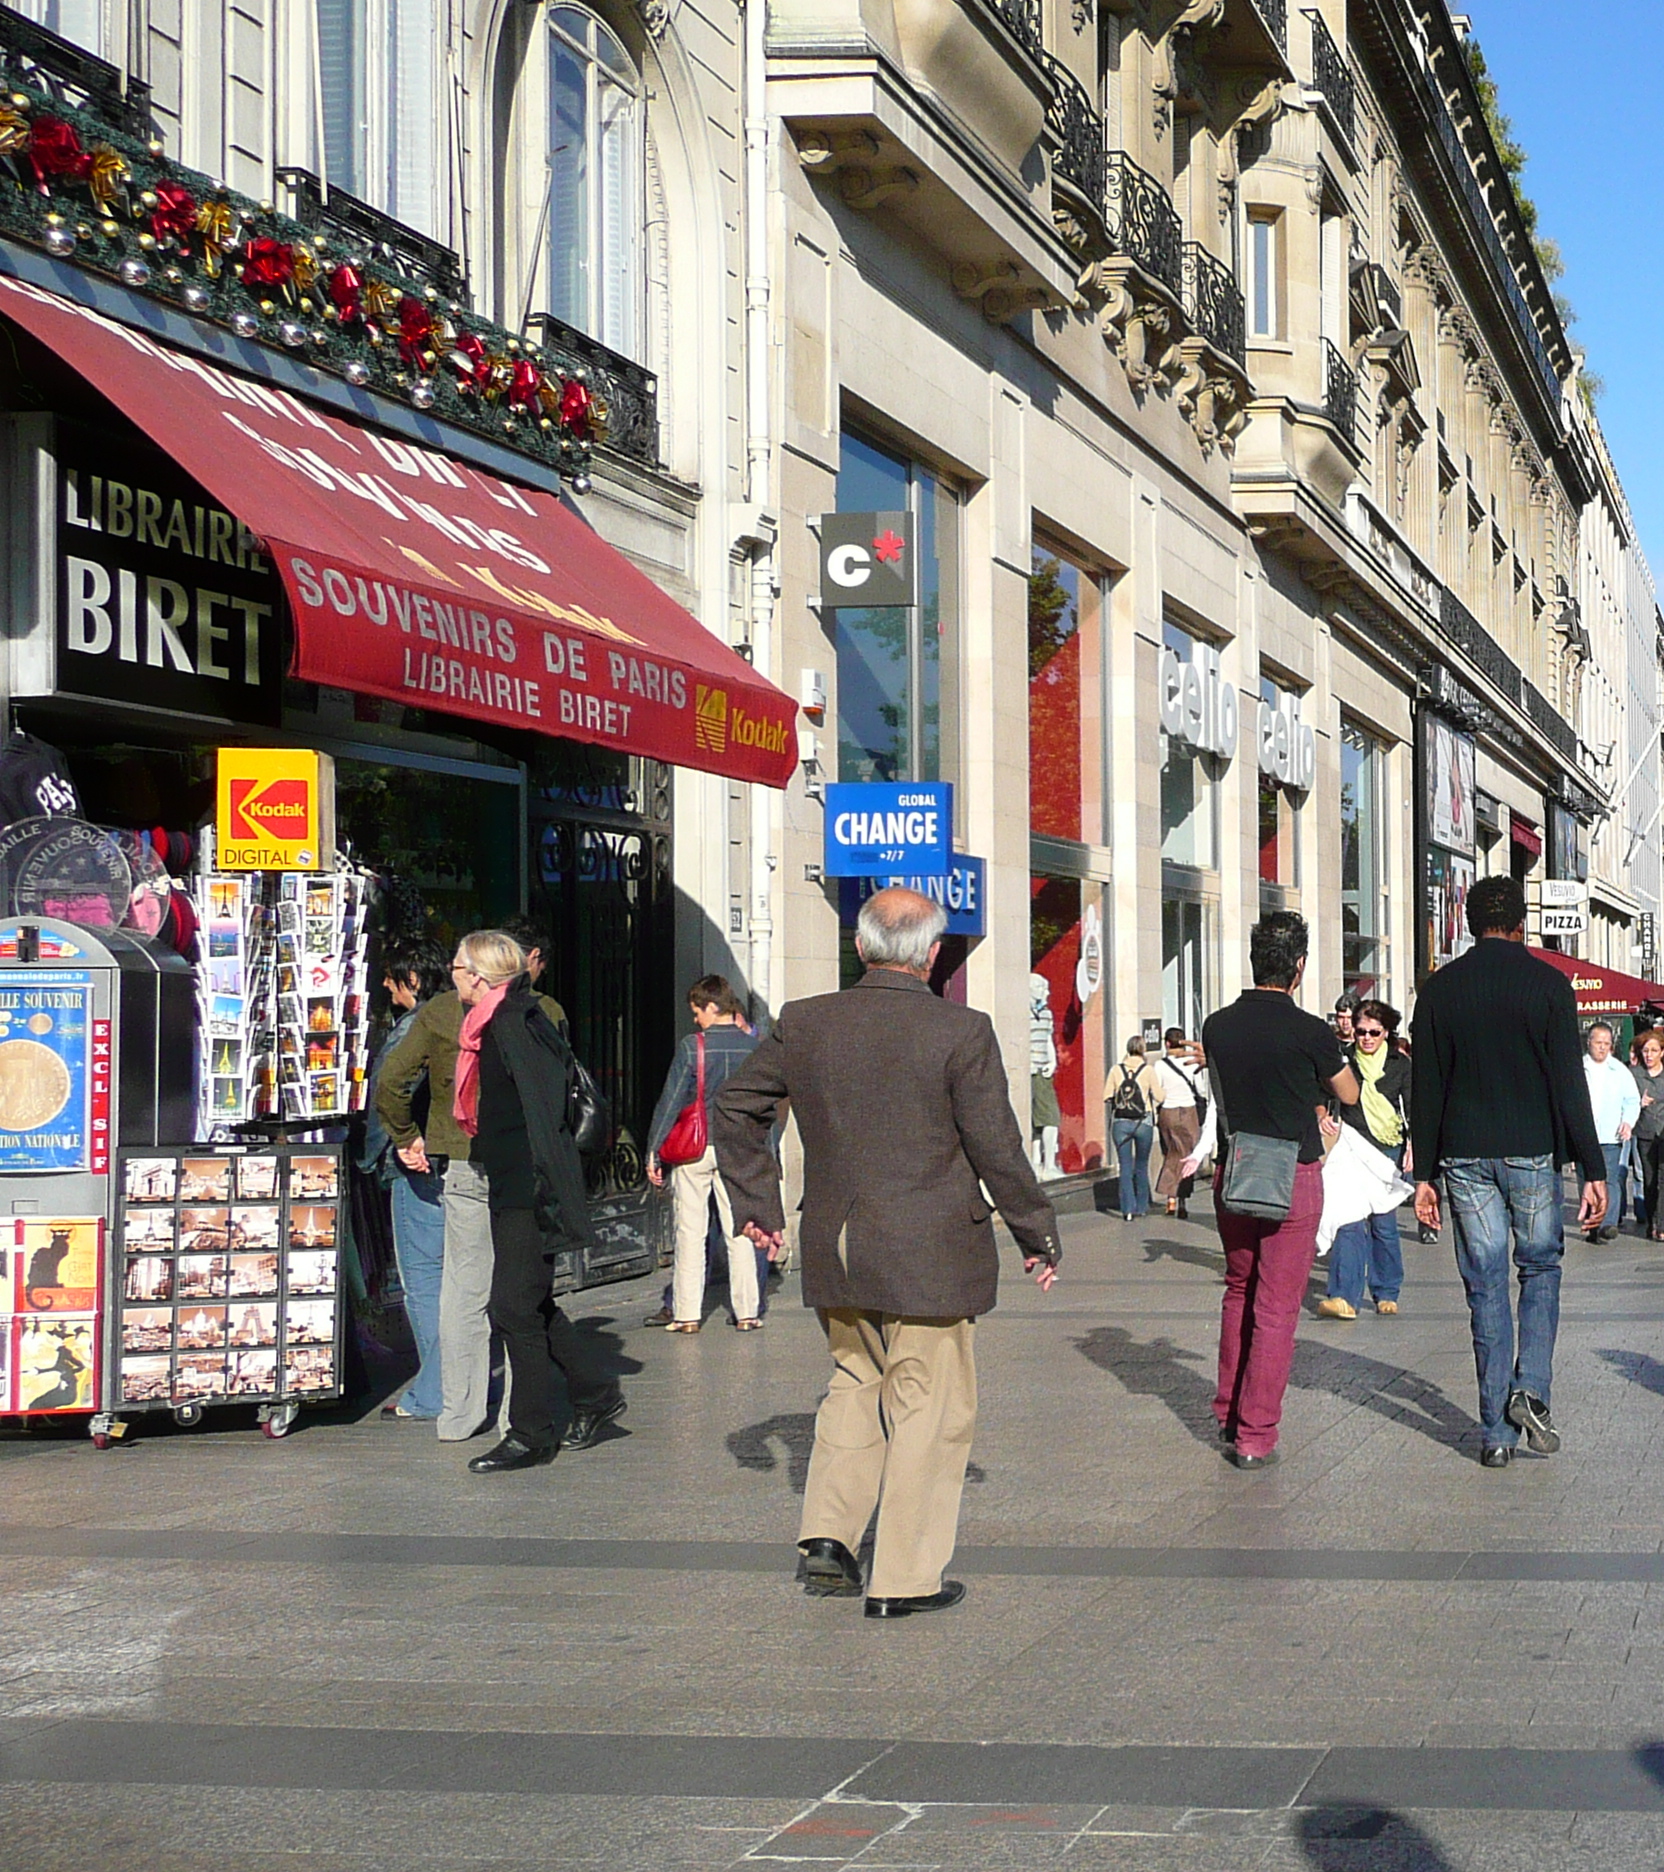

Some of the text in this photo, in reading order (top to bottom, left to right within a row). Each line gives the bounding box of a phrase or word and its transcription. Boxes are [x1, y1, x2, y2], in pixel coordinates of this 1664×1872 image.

[66, 555, 272, 686] BIRET
[290, 557, 687, 710] SOUVENIRS DE PARIS
[403, 648, 632, 739] LIBRAIRIE BIRET
[1158, 642, 1239, 760] celio
[731, 708, 789, 755] Kodak
[1257, 692, 1316, 791] celio
[249, 801, 306, 819] Kodak
[898, 794, 937, 807] GLOBAL
[834, 811, 939, 846] CHANGE
[224, 849, 293, 866] DIGITAL
[869, 868, 976, 911] ANGE
[1544, 915, 1582, 929] PIZZA
[24, 992, 84, 1009] SOUVENIR
[1576, 1000, 1628, 1012] RASSERIE
[92, 1023, 110, 1170] EXCLSIF
[24, 1133, 81, 1148] NATIONLE
